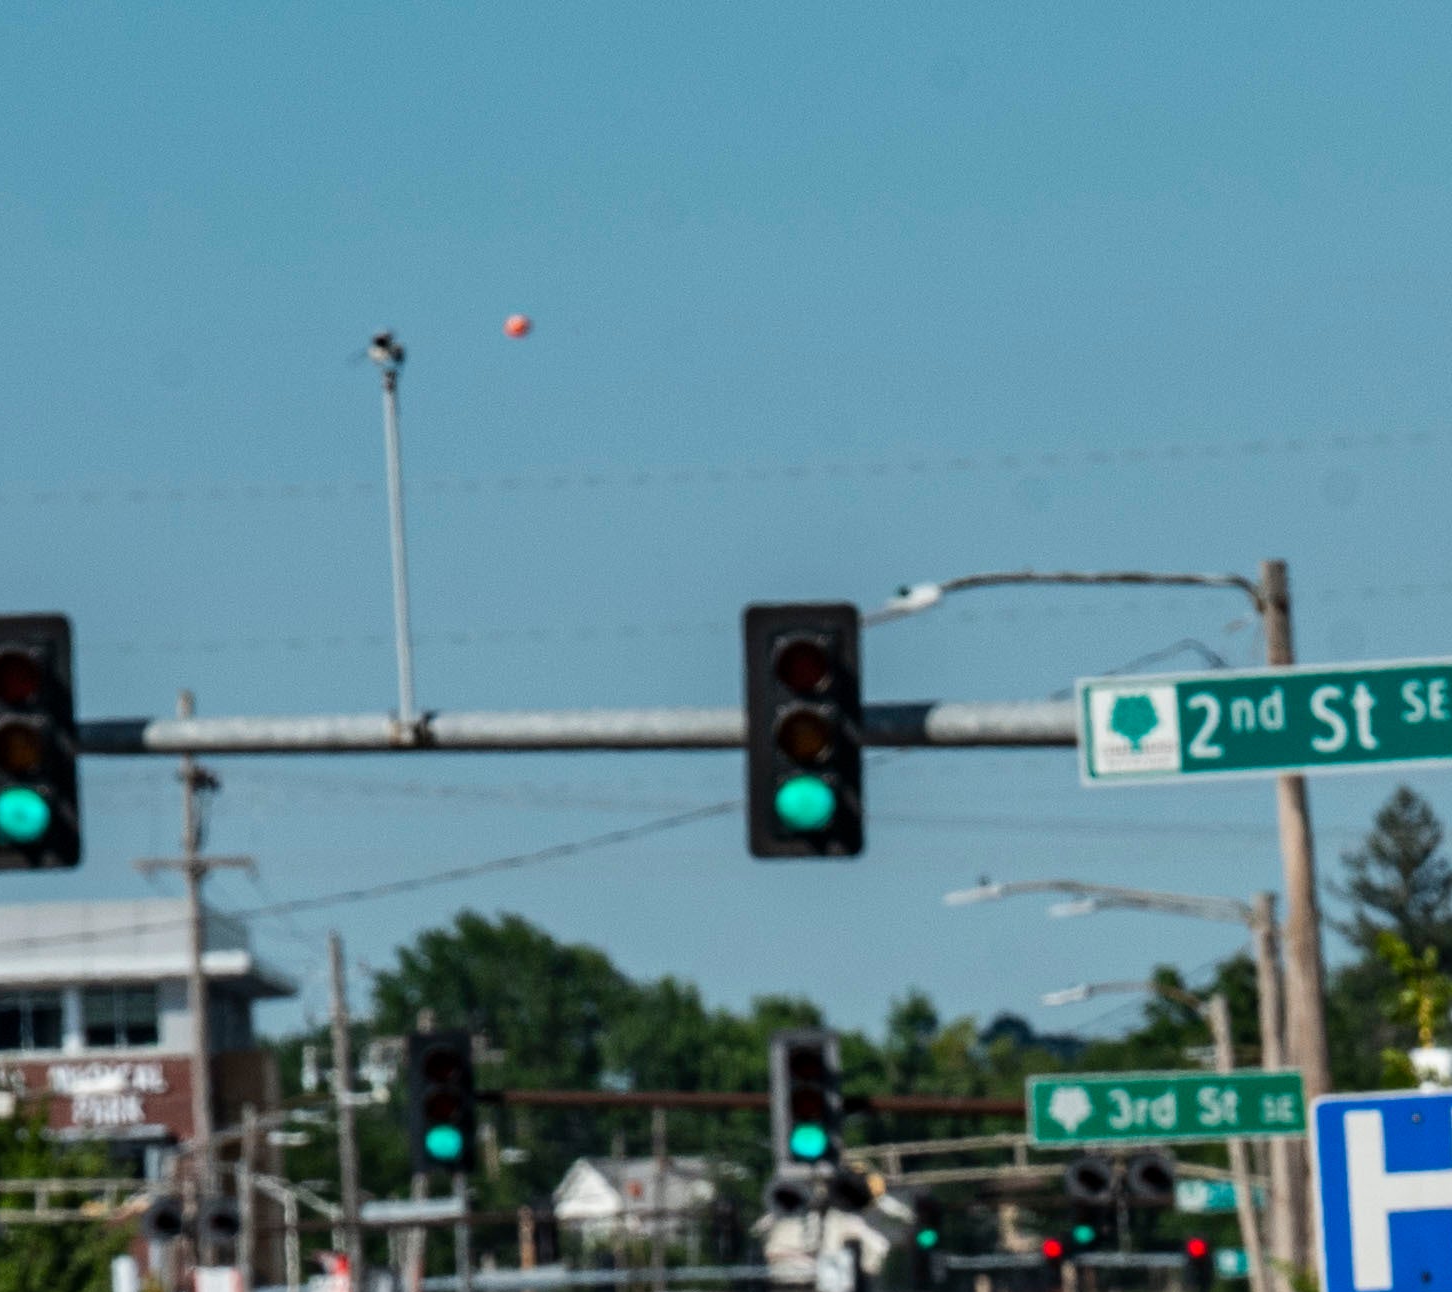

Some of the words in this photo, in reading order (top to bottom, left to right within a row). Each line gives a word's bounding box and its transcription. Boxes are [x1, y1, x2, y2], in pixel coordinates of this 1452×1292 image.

[1188, 684, 1283, 759] 2nd
[1310, 681, 1379, 753] St
[1402, 678, 1449, 723] SE
[1108, 1088, 1177, 1131] 3rd
[1197, 1086, 1241, 1127] St
[1261, 1094, 1296, 1124] SE
